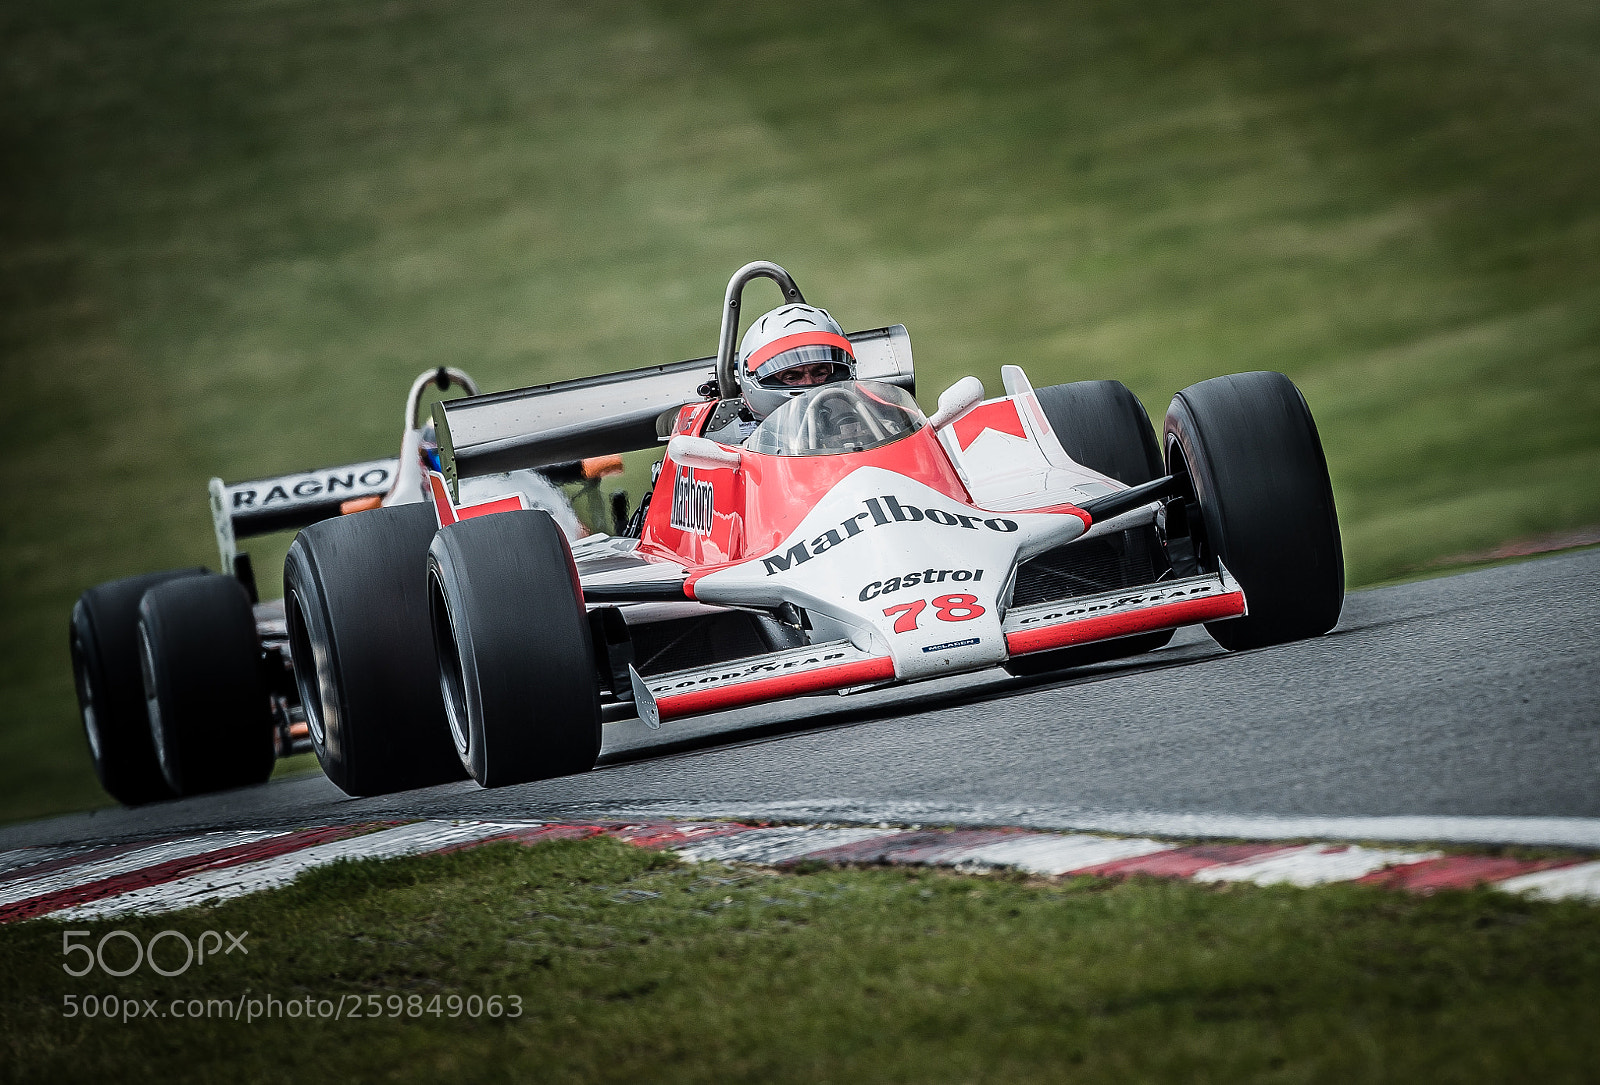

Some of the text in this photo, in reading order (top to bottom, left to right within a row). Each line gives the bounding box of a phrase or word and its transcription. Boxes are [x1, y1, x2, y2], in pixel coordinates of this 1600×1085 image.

[232, 469, 390, 508] RAGNO
[760, 495, 1019, 577] Marlboro
[882, 594, 986, 634] 78
